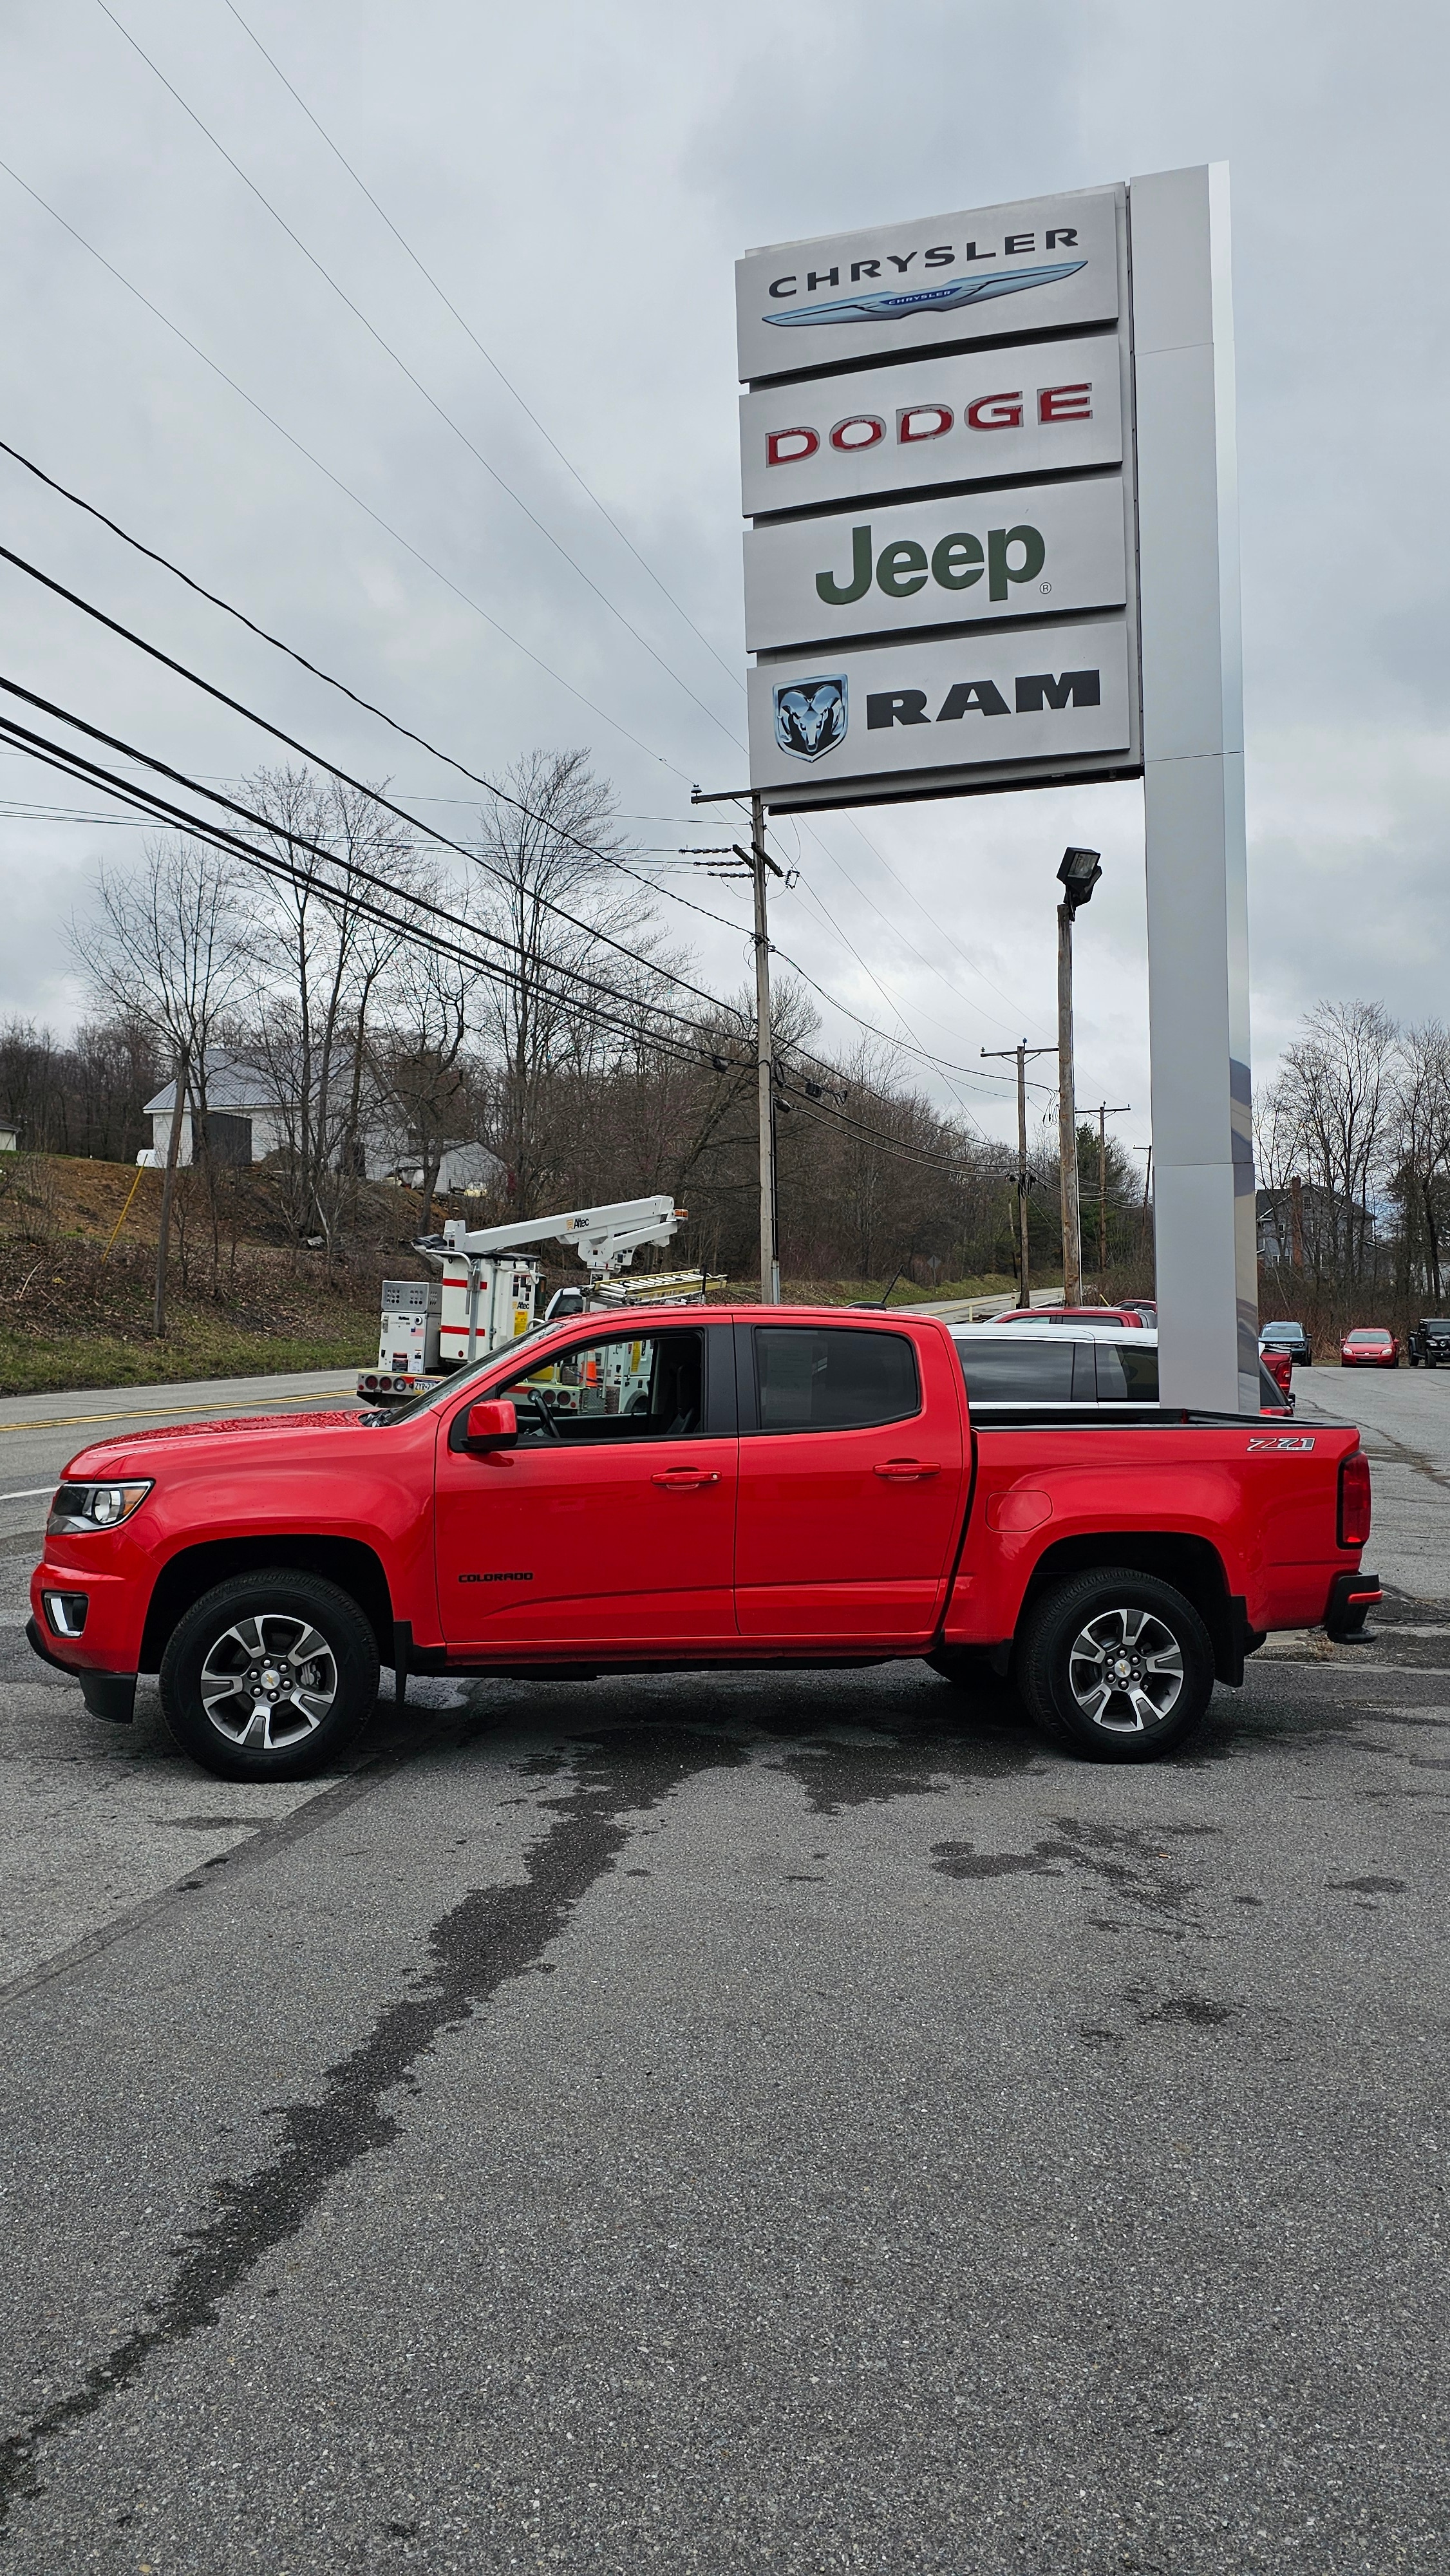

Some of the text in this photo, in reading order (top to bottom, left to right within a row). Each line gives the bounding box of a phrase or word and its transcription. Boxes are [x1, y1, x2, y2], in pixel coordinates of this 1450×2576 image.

[769, 228, 1078, 298] CHRYSLER
[889, 290, 951, 305] CHRYSLER
[766, 383, 1093, 468] DODGE
[815, 524, 1046, 605] Jeep
[866, 669, 1100, 730] RAM
[1247, 1437, 1315, 1452] Z71
[458, 1572, 534, 1583] COLORADO
